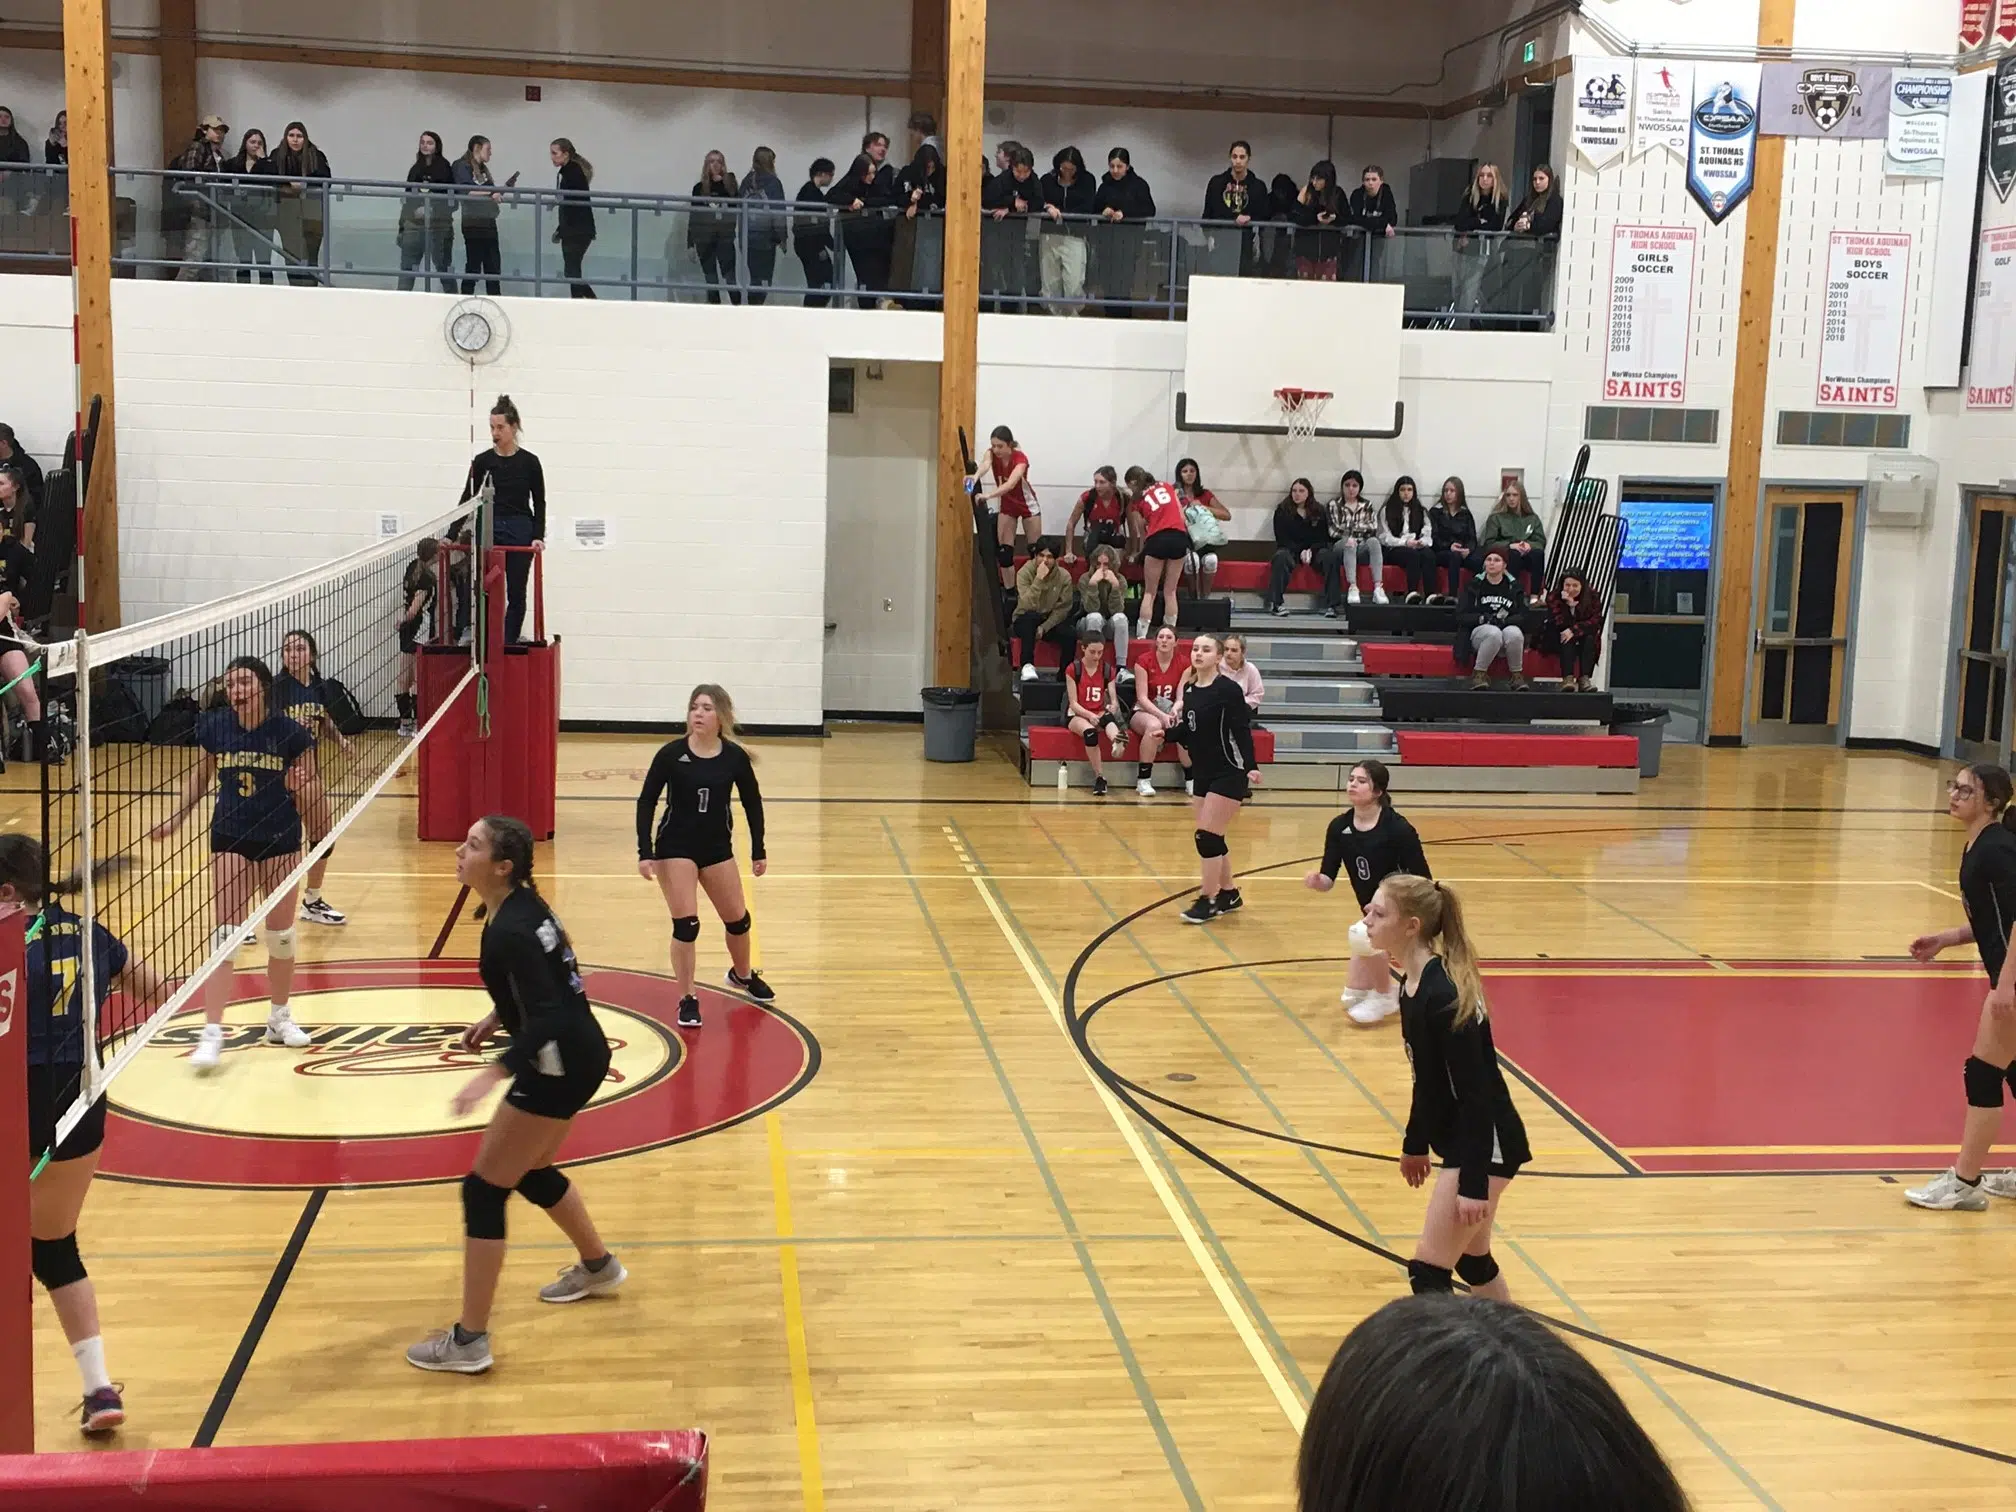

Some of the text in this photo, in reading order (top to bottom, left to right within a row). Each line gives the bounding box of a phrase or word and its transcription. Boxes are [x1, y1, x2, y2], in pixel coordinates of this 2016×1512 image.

[1797, 83, 1861, 95] OFSAA
[1896, 83, 1951, 95] CHAMPIONSHIP
[1638, 122, 1685, 132] NWOSSAA
[1712, 146, 1744, 156] THOMAS
[1900, 147, 1938, 155] NWOSSAA
[1698, 156, 1744, 166] AQUINAS HS
[1703, 169, 1738, 179] NWOSSAA
[1630, 230, 1659, 239] THOMAS
[1661, 231, 1694, 240] AQUINAS
[1630, 240, 1676, 250] HIGH SCHOOL
[1845, 236, 1875, 246] THOMAS
[1876, 237, 1909, 247] AQUINAS
[1846, 246, 1891, 256] HIGH SCHOOL
[1637, 253, 1669, 262] GIRLS
[1994, 256, 2012, 266] GOLF
[1631, 264, 1674, 274] SOCCER
[1853, 259, 1883, 269] BOYS
[1614, 276, 1635, 284] 2009
[1846, 270, 1889, 280] SOCCER
[1614, 285, 1634, 293] 2010
[1829, 281, 1849, 290] 2009
[1613, 295, 1633, 303] 2012
[1828, 291, 1849, 299] 2010
[1612, 304, 1633, 312] 2013
[1828, 300, 1847, 308] 2011
[1827, 309, 1847, 317] 2013
[1612, 321, 1632, 329] 2015
[1826, 318, 1846, 326] 2014
[1825, 326, 1846, 334] 2016
[1610, 344, 1631, 352] 2018
[1643, 371, 1678, 380] Champions
[1857, 376, 1891, 384] Champions
[1606, 379, 1683, 398] SAINTS
[1819, 383, 1895, 403] SAINTS
[1968, 385, 2013, 404] SAINTS
[1144, 486, 1172, 512] 16
[1480, 595, 1513, 608] ROOKLYN
[1085, 686, 1102, 702] 15
[1156, 684, 1173, 698] 12
[1187, 710, 1197, 732] 3
[238, 771, 256, 798] 3
[697, 787, 710, 813] 1
[1355, 855, 1371, 881] 9
